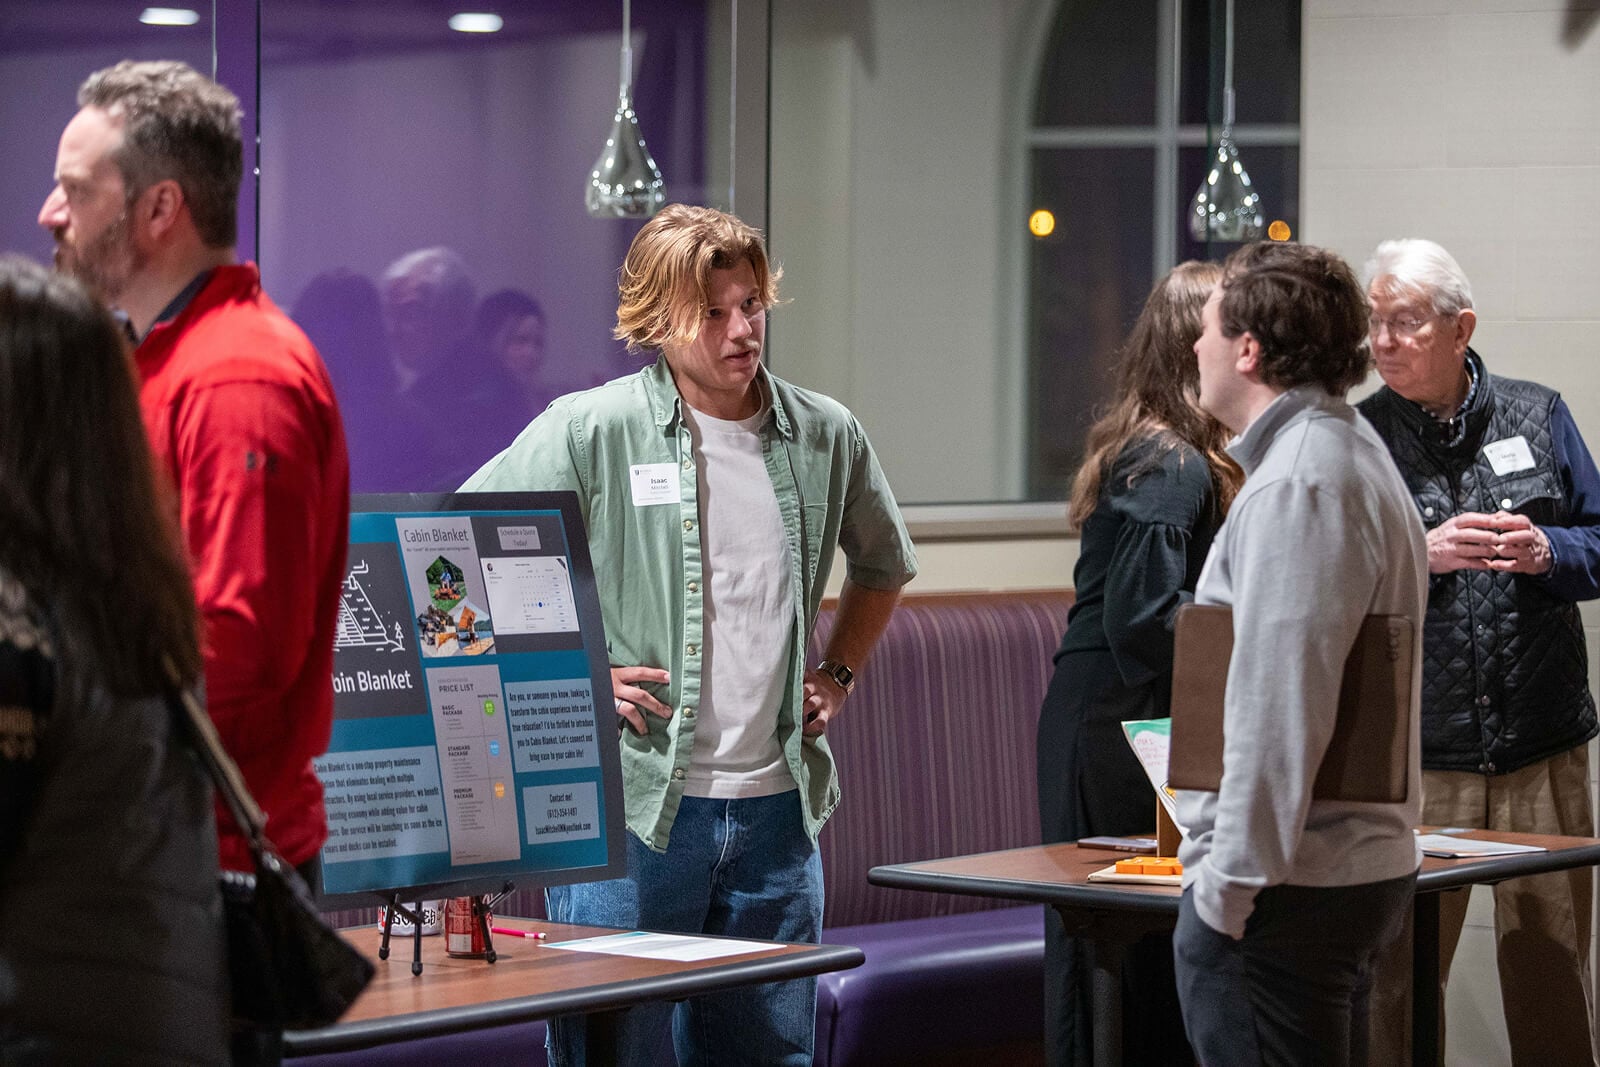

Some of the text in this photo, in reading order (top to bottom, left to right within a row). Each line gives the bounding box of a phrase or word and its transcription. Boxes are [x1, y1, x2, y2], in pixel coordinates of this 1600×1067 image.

[403, 528, 469, 543] Cabin Blanket
[500, 528, 519, 537] Schedule
[524, 527, 536, 536] Quote
[513, 539, 527, 547] Today!
[331, 669, 413, 693] bin Blanket
[439, 683, 474, 693] PRICE LIST
[532, 692, 550, 700] someone
[570, 689, 585, 699] looking
[585, 688, 590, 697] to
[510, 708, 530, 717] transform
[538, 706, 550, 715] cabin
[550, 706, 570, 716] experience
[570, 704, 579, 713] into
[556, 720, 570, 729] thrilled
[570, 719, 576, 728] to
[576, 718, 594, 728] introduce
[525, 738, 530, 746] to
[530, 737, 542, 746] Cabin
[558, 735, 569, 744] Let's
[569, 734, 584, 743] connect
[529, 752, 540, 764] bring
[550, 752, 554, 760] to
[556, 752, 564, 761] your
[565, 750, 576, 759] cabin
[328, 762, 346, 772] Blanket
[374, 760, 393, 772] property
[394, 758, 420, 767] maintenance
[336, 778, 345, 788] that
[346, 777, 368, 787] eliminates
[370, 775, 386, 786] dealing
[386, 775, 396, 784] with
[354, 794, 366, 804] using
[366, 792, 378, 802] local
[378, 792, 394, 800] service
[424, 787, 439, 796] benefit
[550, 792, 573, 804] Contact me!
[348, 810, 368, 820] economy
[380, 806, 396, 818] adding
[416, 804, 428, 813] cabin
[350, 826, 366, 835] service
[367, 824, 375, 834] will
[375, 824, 382, 832] be
[382, 822, 403, 833] launching
[410, 822, 420, 830] soon
[339, 842, 348, 852] and
[348, 842, 362, 851] docks
[371, 840, 378, 849] be
